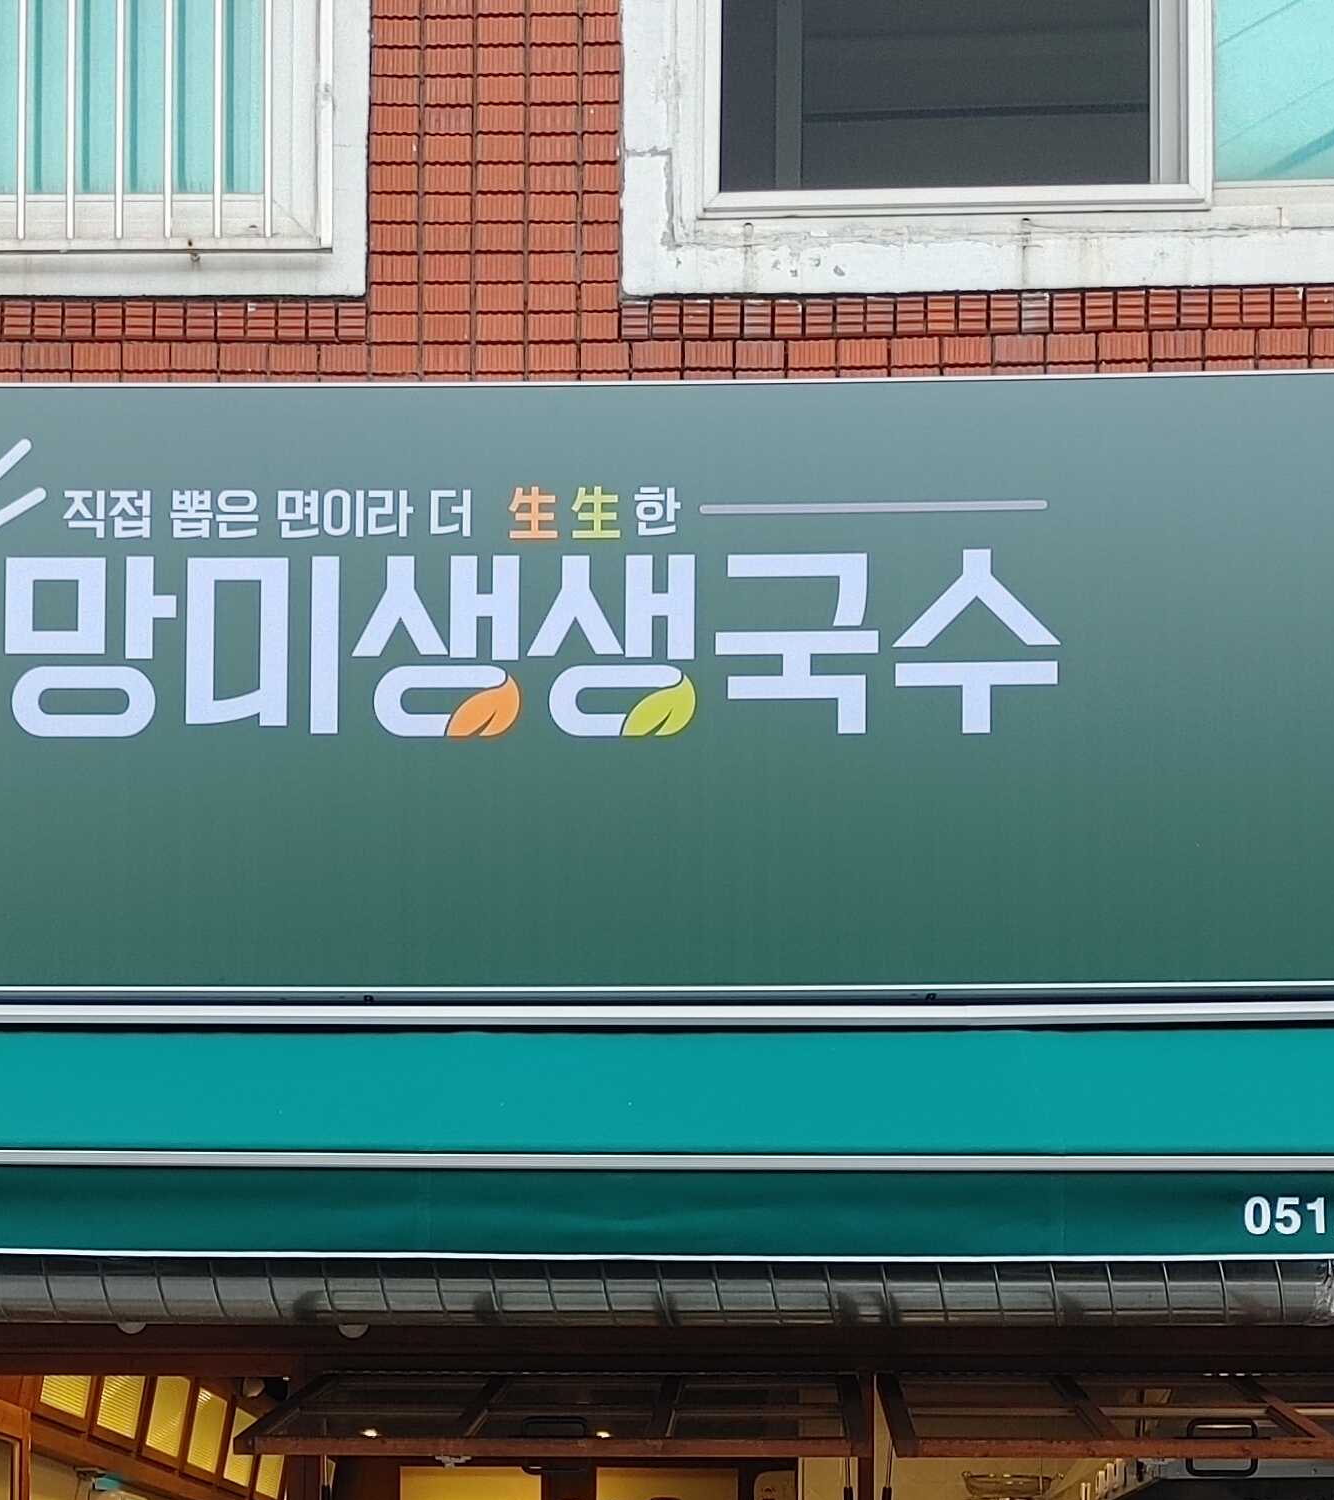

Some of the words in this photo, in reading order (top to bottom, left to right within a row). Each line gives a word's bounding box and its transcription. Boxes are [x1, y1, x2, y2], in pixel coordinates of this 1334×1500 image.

[63, 490, 152, 538] 직접
[170, 490, 259, 538] 뽑은
[277, 490, 413, 538] 면이라
[430, 489, 472, 537] 더
[5, 548, 1061, 738] 망미생생국수
